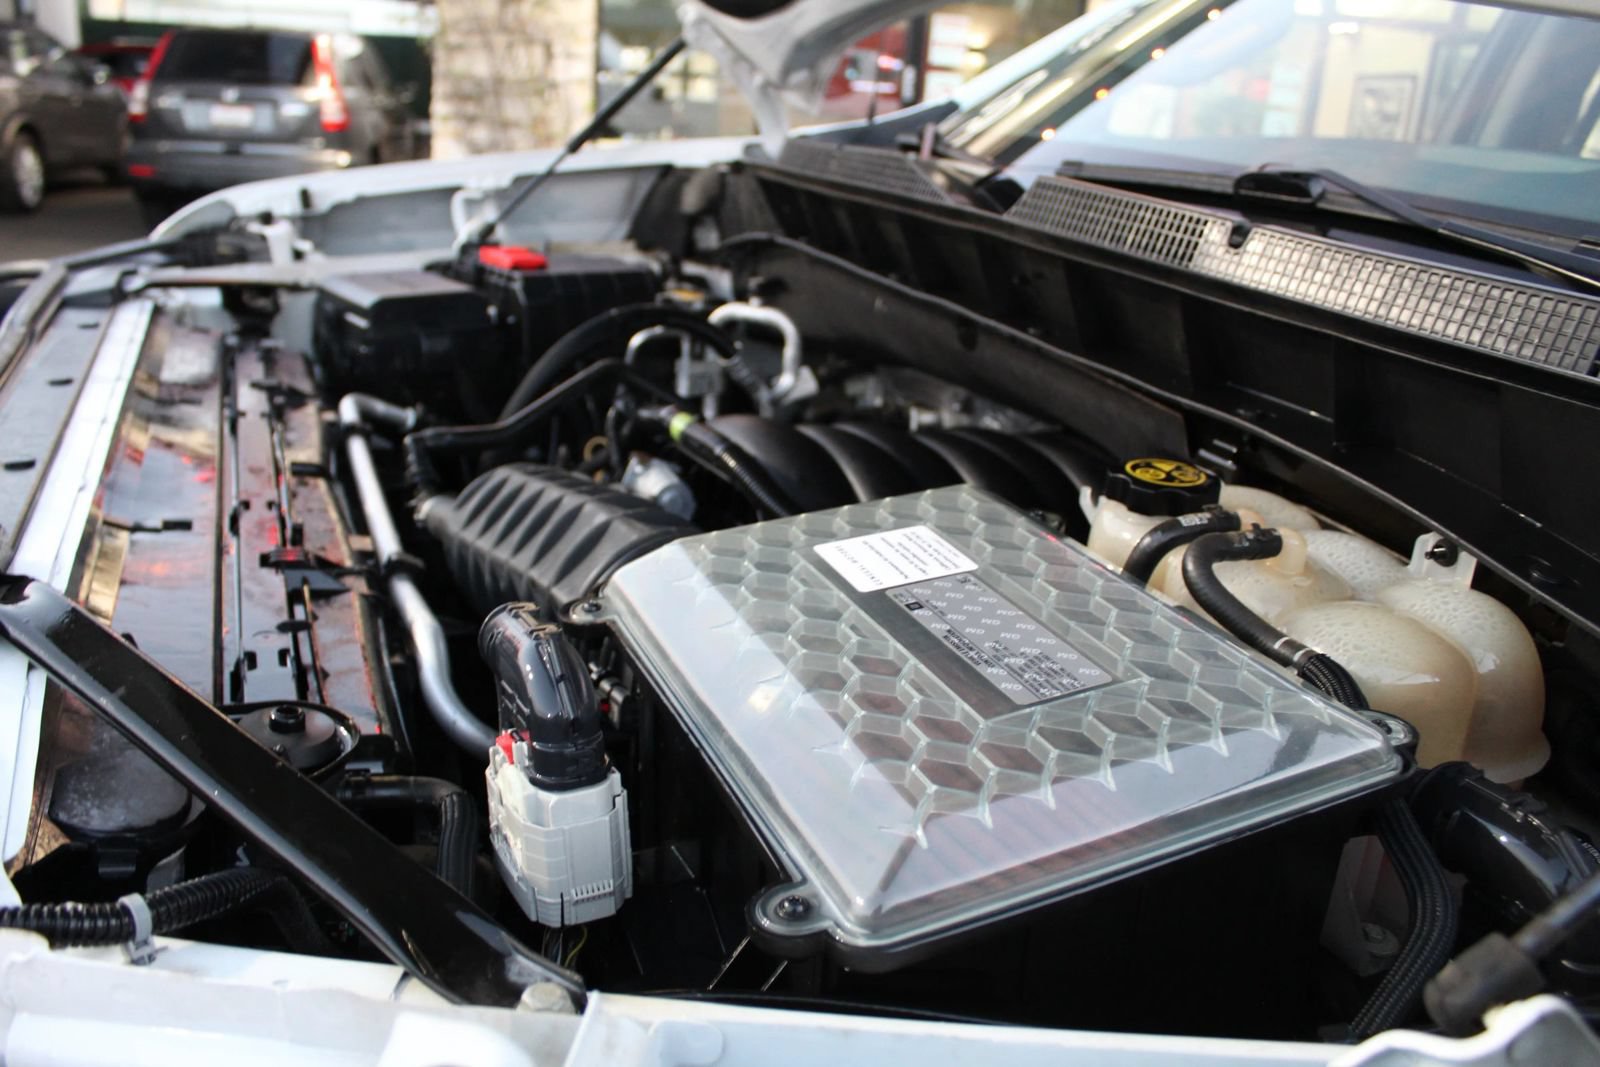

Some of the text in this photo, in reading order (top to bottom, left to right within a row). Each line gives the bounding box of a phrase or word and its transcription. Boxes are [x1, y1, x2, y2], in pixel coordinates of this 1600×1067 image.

[1020, 646, 1040, 654] GM
[1056, 652, 1077, 660] GM
[1000, 682, 1022, 690] GM
